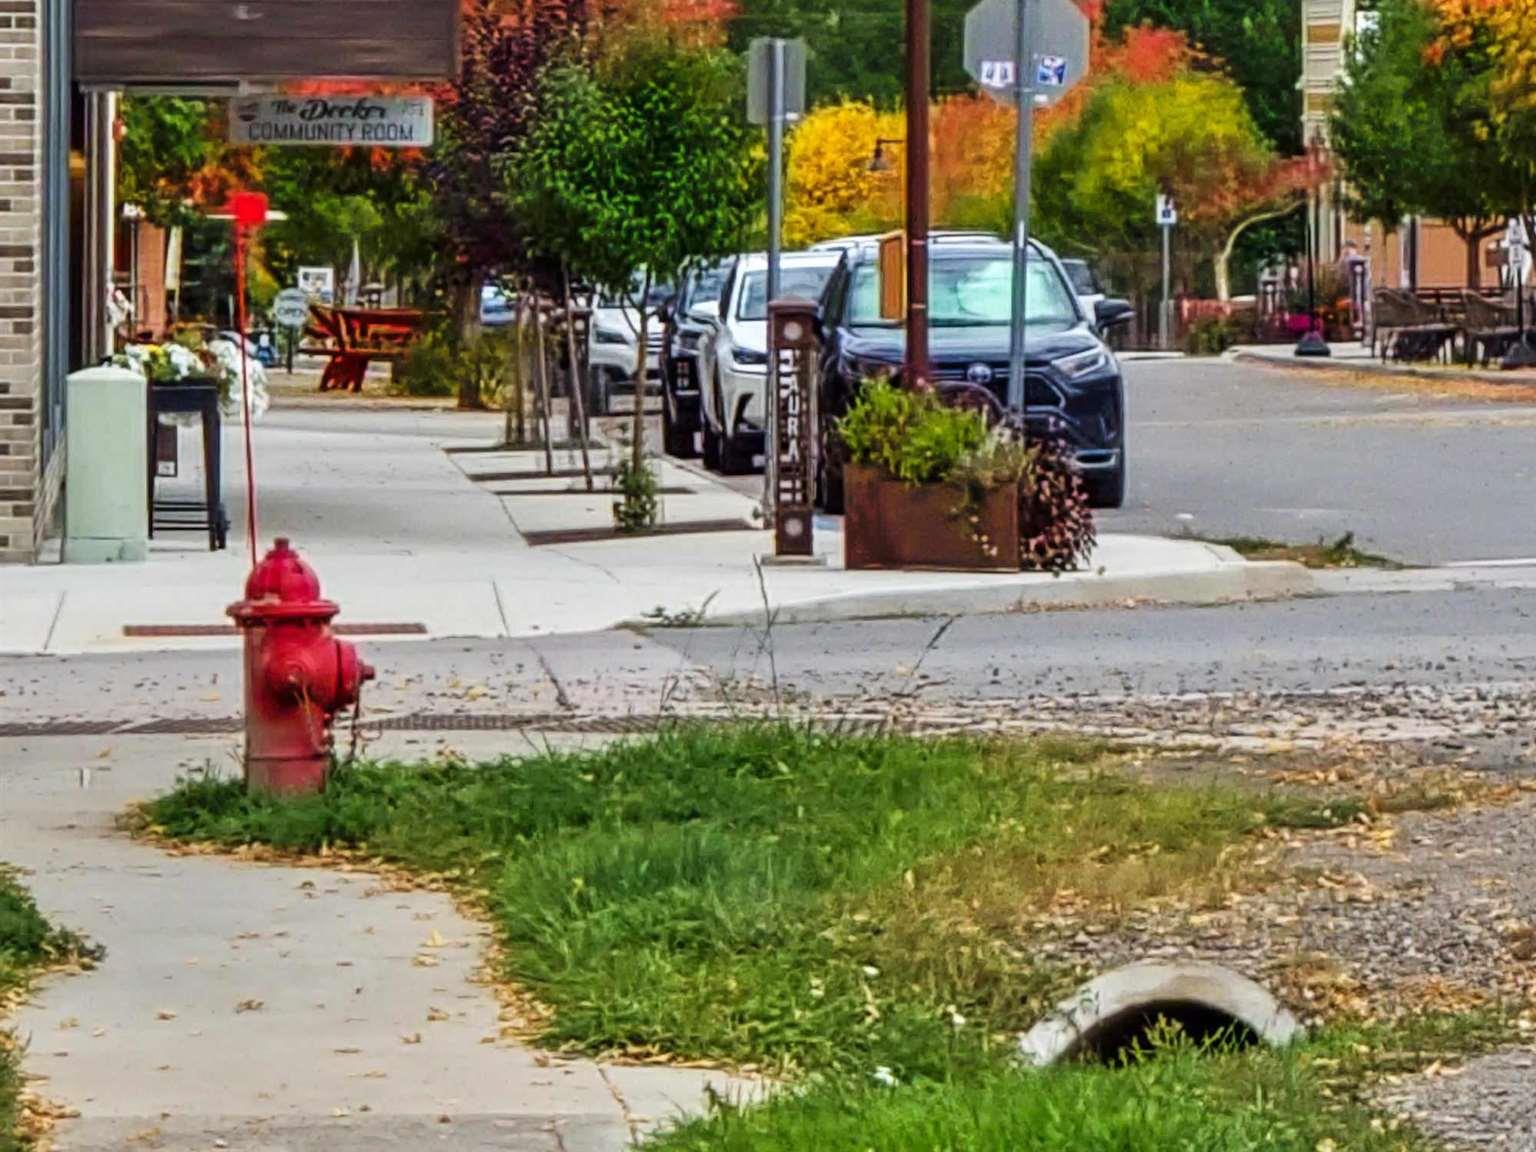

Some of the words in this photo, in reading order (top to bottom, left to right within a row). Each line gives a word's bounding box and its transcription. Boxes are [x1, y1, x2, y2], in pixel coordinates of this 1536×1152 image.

[271, 99, 297, 114] The
[249, 122, 354, 141] COMMUNITY
[361, 122, 413, 141] ROOM
